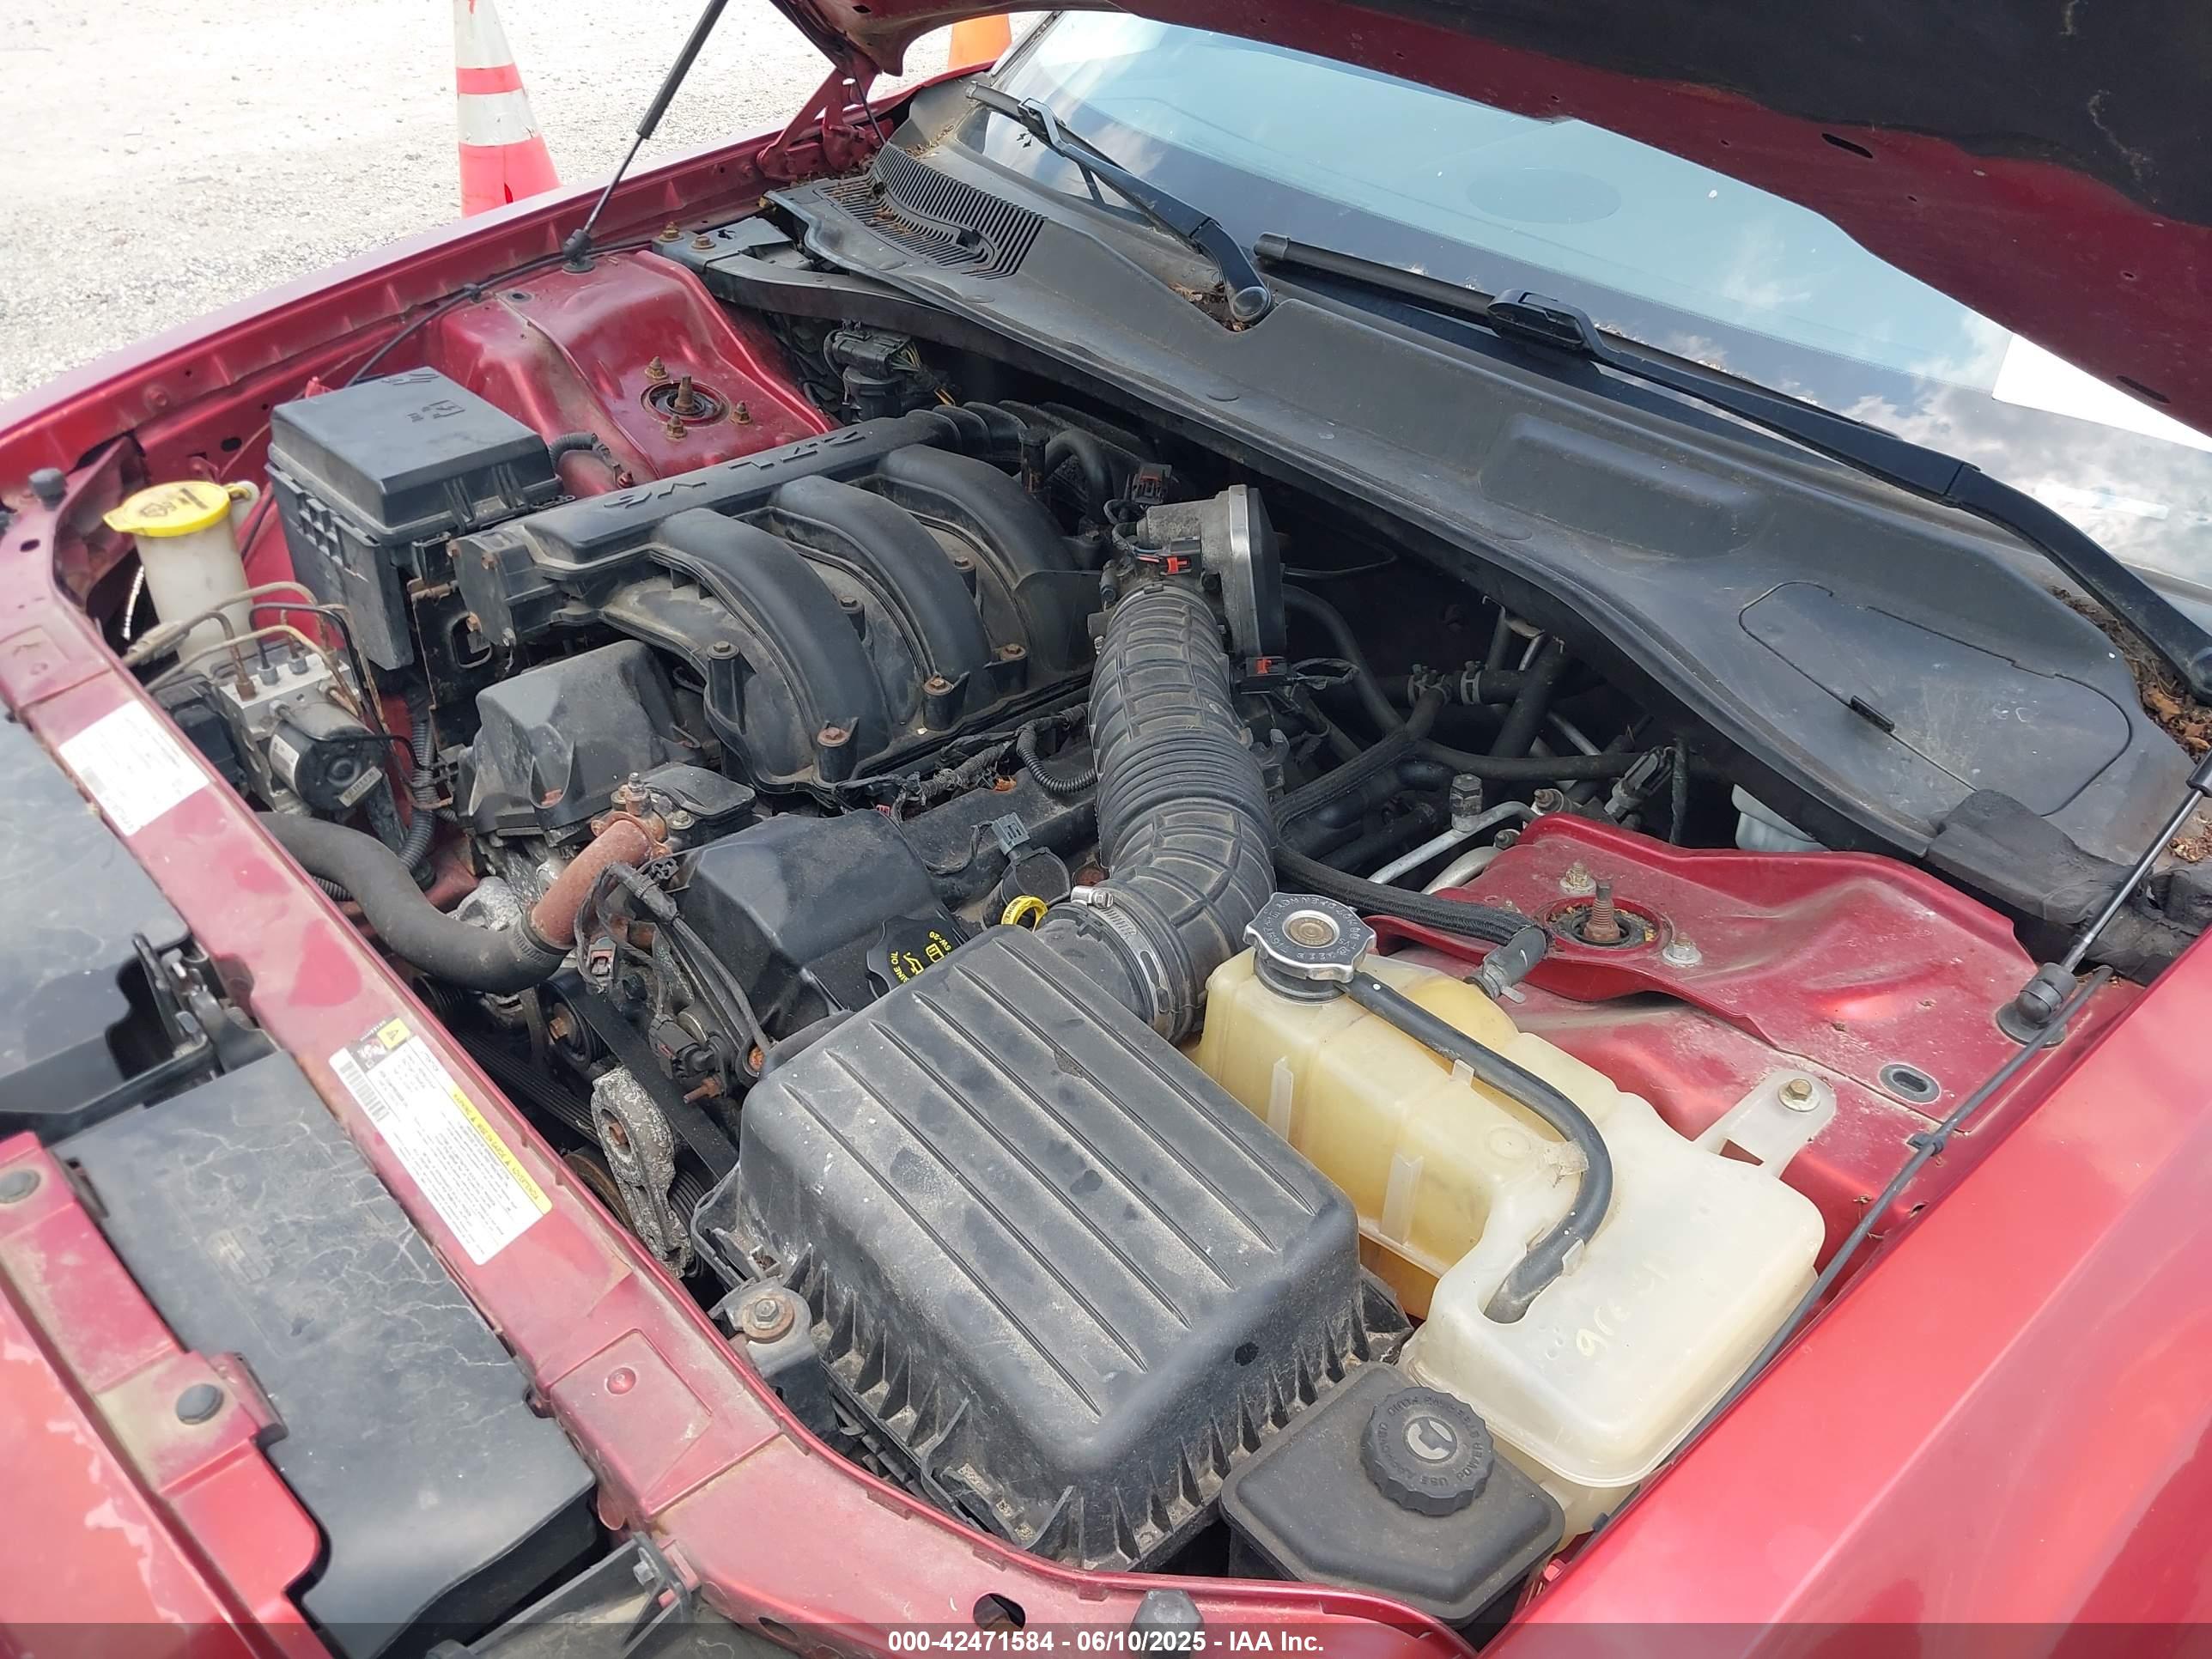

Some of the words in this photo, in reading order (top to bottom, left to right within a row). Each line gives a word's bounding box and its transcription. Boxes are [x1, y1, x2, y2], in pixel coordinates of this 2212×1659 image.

[729, 431, 866, 470] 2.7L
[604, 481, 707, 509] V6
[928, 931, 951, 951] 5W-20
[890, 951, 899, 963] OIL
[1388, 1396, 1418, 1417] FLUID
[1457, 1443, 1483, 1482] POWER
[1421, 1475, 1449, 1487] USE
